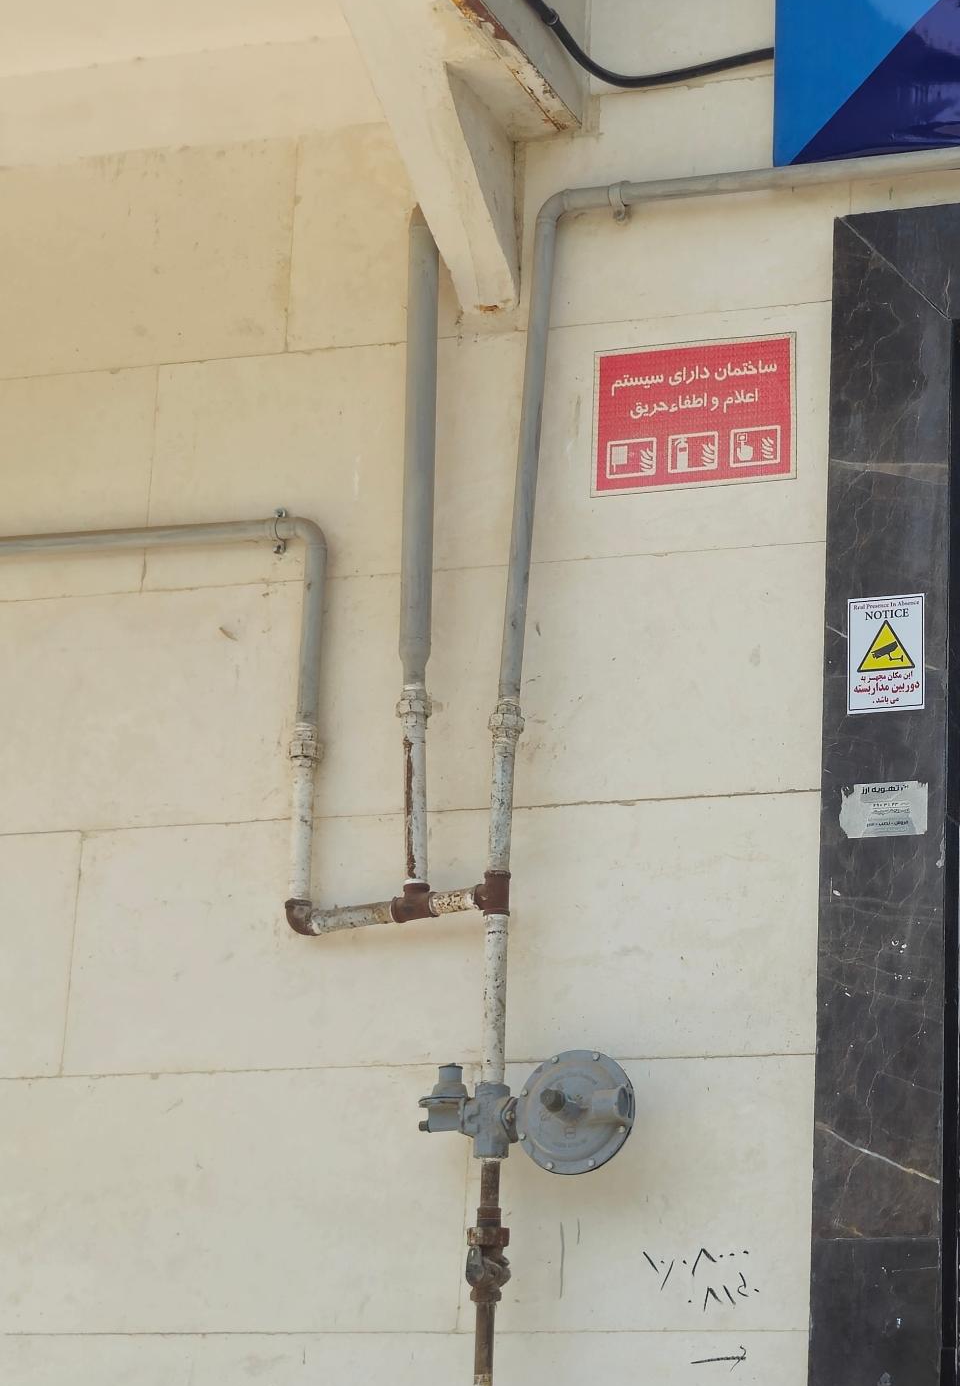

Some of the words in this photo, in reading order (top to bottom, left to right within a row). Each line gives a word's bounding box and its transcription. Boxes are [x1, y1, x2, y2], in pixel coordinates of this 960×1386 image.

[669, 366, 710, 385] دارای
[714, 360, 778, 381] ساختمان
[611, 373, 664, 396] سیستم
[711, 398, 719, 411] و
[723, 388, 759, 412] اعلام
[865, 608, 909, 620] NOTICE
[888, 672, 902, 681] مکان
[903, 671, 913, 680] این
[853, 682, 890, 695] مداربسته
[892, 681, 920, 693] دوربین
